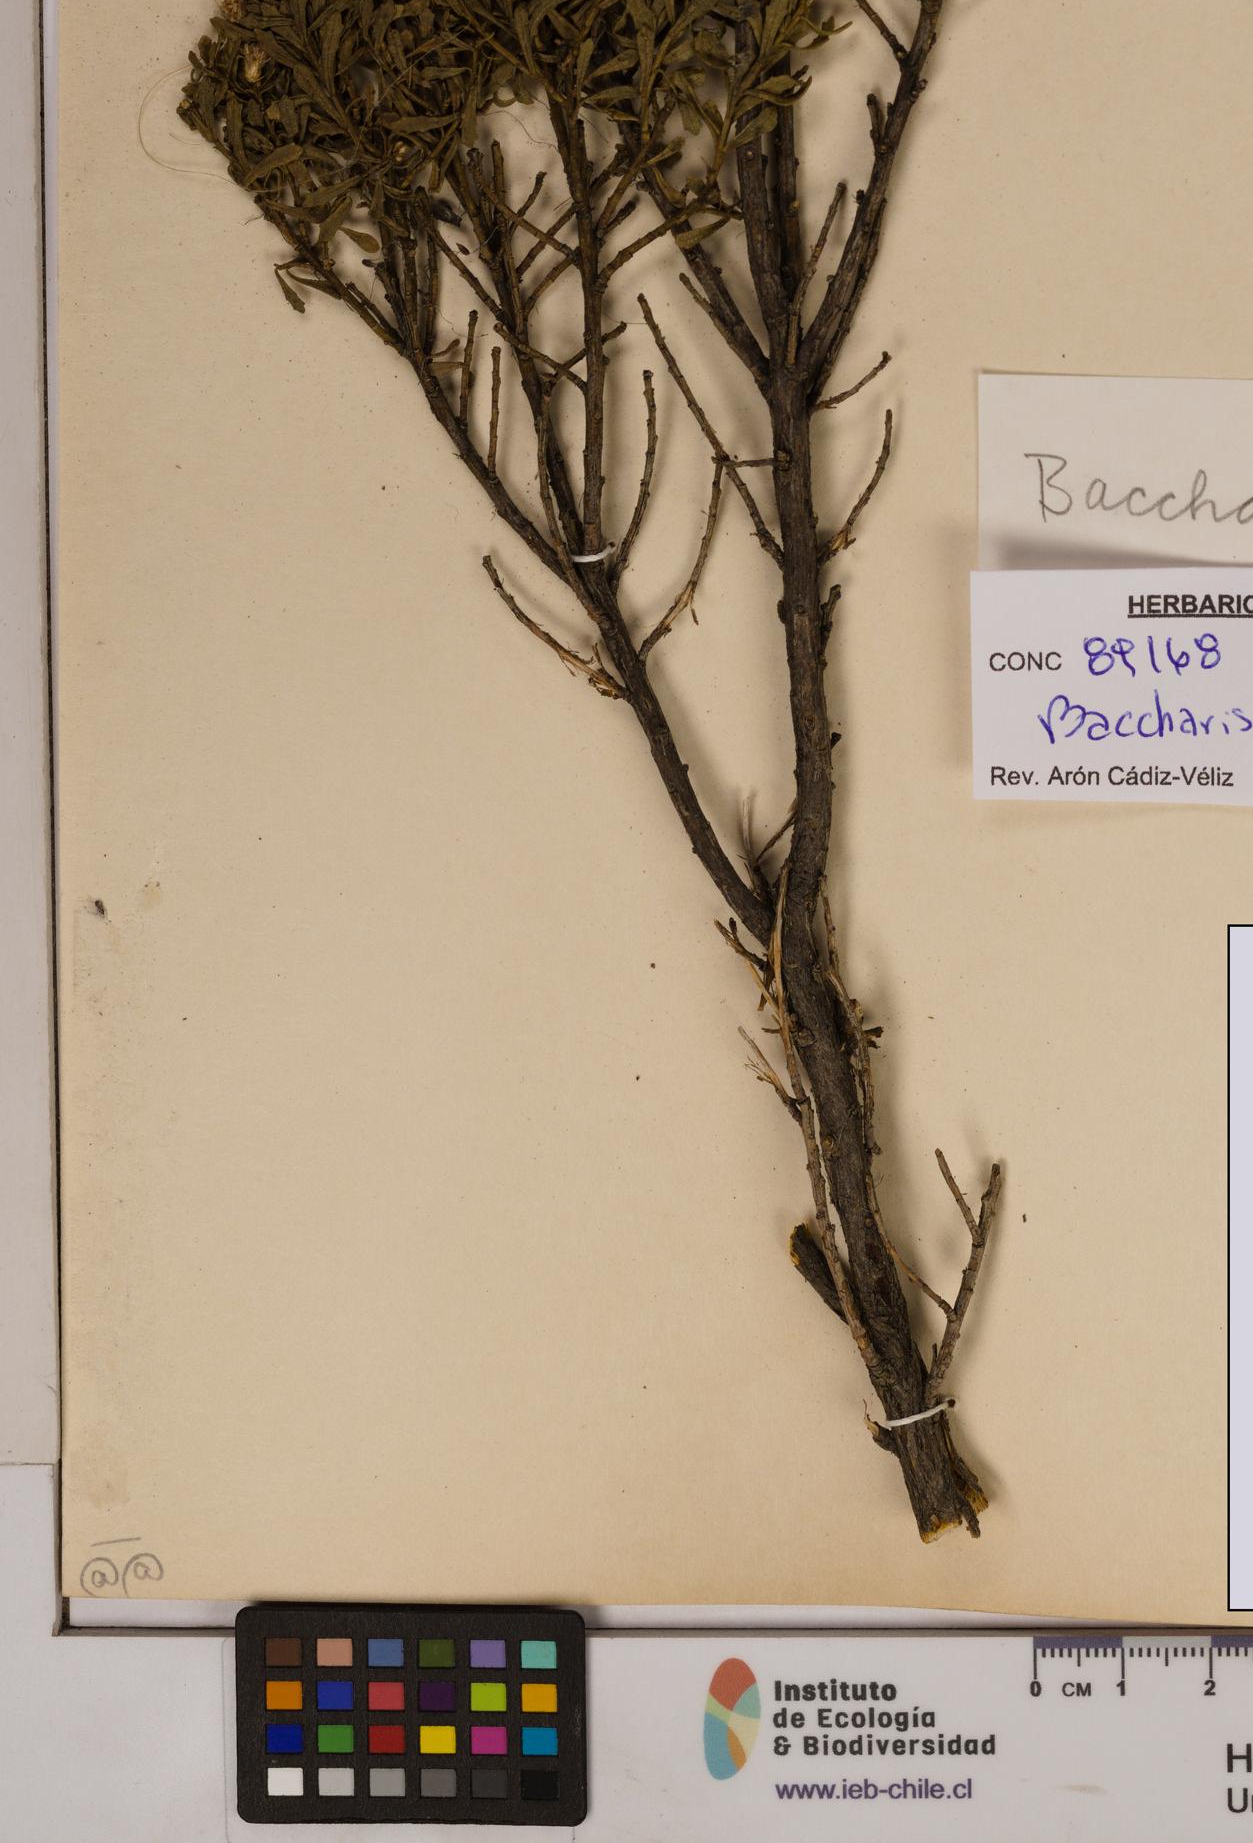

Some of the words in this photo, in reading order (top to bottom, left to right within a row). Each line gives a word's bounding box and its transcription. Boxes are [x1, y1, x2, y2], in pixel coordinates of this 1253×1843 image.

[989, 651, 1062, 672] CONC
[1083, 633, 1221, 678] 89168
[1037, 693, 1253, 745] Baccharis
[990, 765, 1039, 786] Rev.
[1047, 765, 1100, 786] Arón
[1107, 765, 1234, 787] Cádiz-Véliz
[774, 1678, 897, 1702] Instituto
[1029, 1680, 1042, 1698] 0
[1061, 1682, 1092, 1698] CM
[1116, 1679, 1126, 1697] 1
[1203, 1679, 1216, 1696] 2
[772, 1707, 806, 1729] de
[817, 1706, 936, 1733] Ecología
[773, 1735, 792, 1757] &
[803, 1733, 996, 1756] Biodiversidad
[774, 1777, 973, 1800] www.ieb-chile.cl
